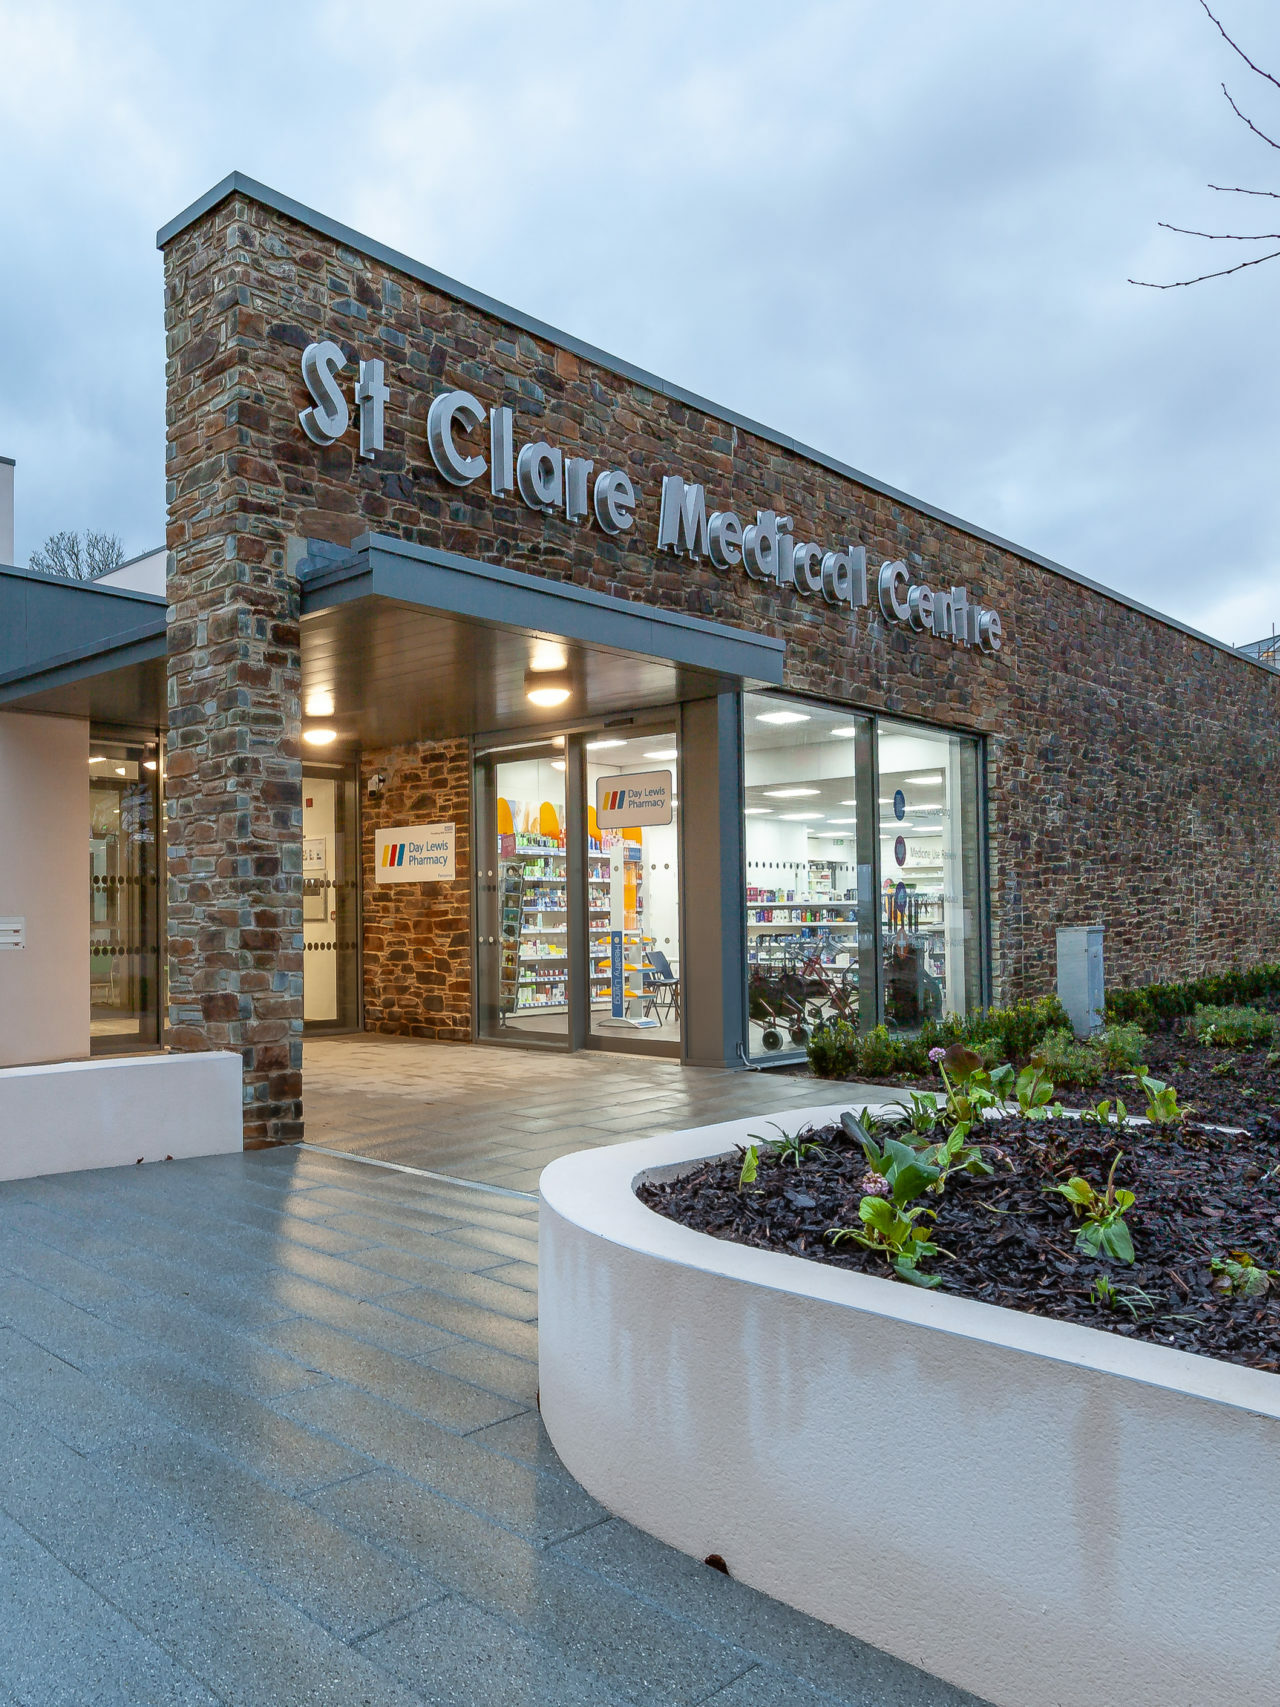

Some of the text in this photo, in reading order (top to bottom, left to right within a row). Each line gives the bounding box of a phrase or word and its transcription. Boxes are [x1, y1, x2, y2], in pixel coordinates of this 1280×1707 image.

[298, 340, 1003, 654] St Clare Medical Centre
[628, 786, 666, 799] Day Lewis
[628, 799, 666, 809] Pharmacy
[408, 840, 449, 855] Day Lewis
[408, 854, 448, 867] Pharmacy
[613, 944, 622, 1005] Healthy Living
